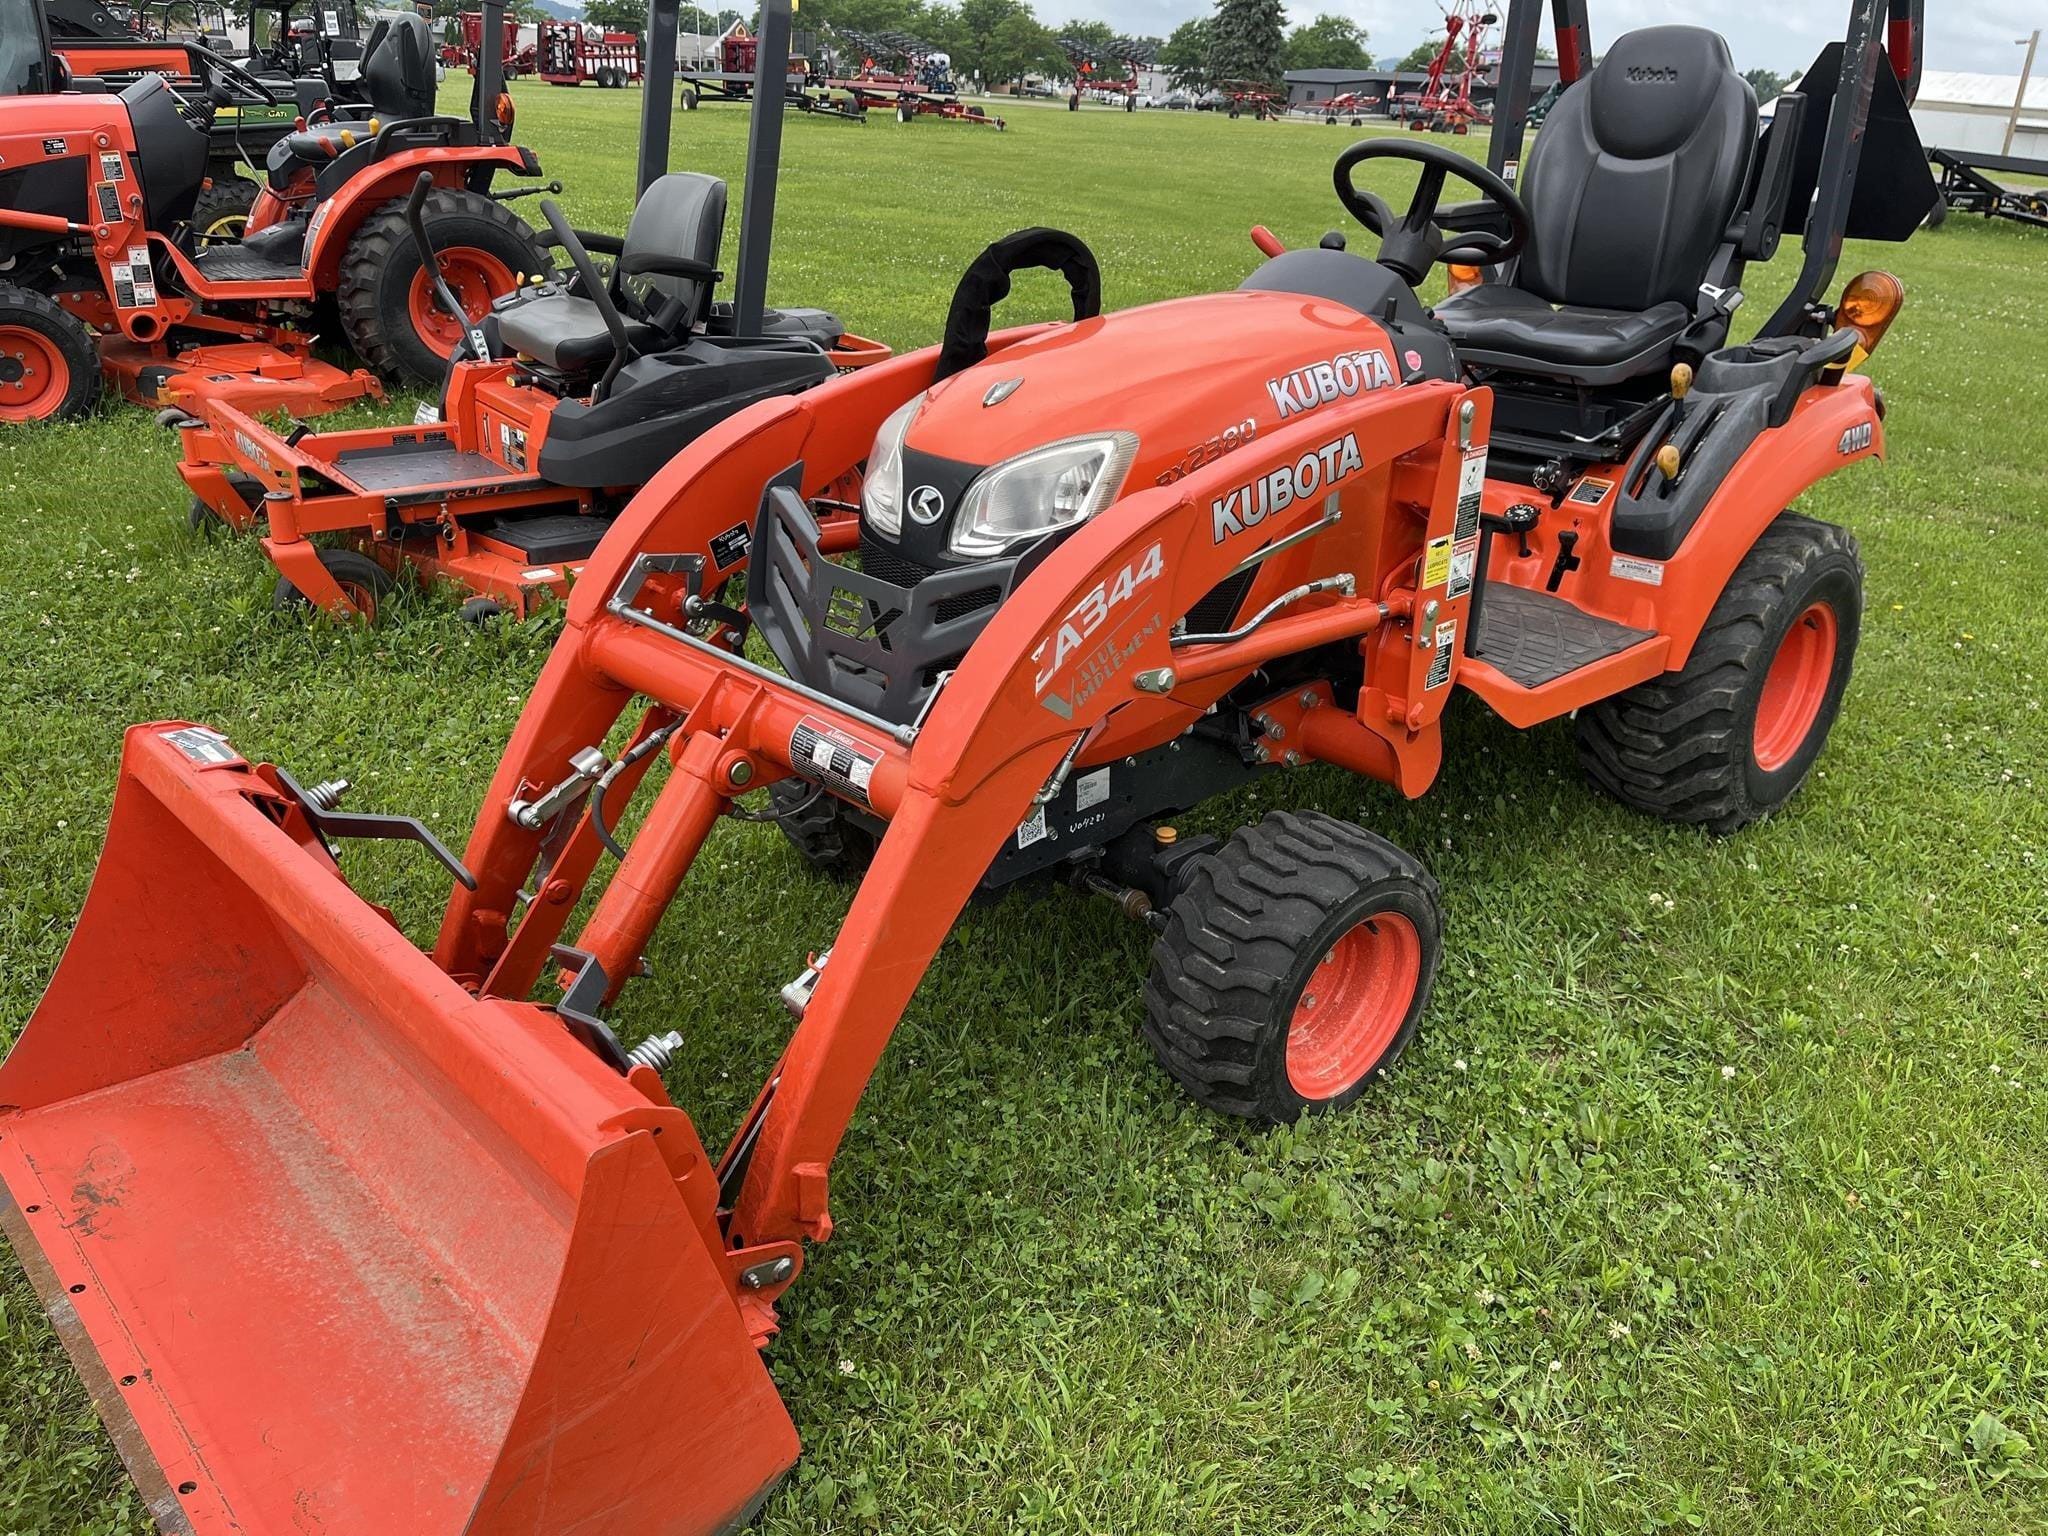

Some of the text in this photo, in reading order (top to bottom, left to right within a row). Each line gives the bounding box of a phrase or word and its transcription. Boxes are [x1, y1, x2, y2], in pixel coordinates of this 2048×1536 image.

[1626, 65, 1678, 84] Kubota
[1267, 350, 1395, 419] KUBOTA
[1837, 421, 1872, 456] 4WD
[446, 486, 501, 498] K-LIFT
[1211, 431, 1364, 545] KUBOTA
[824, 584, 904, 654] BX
